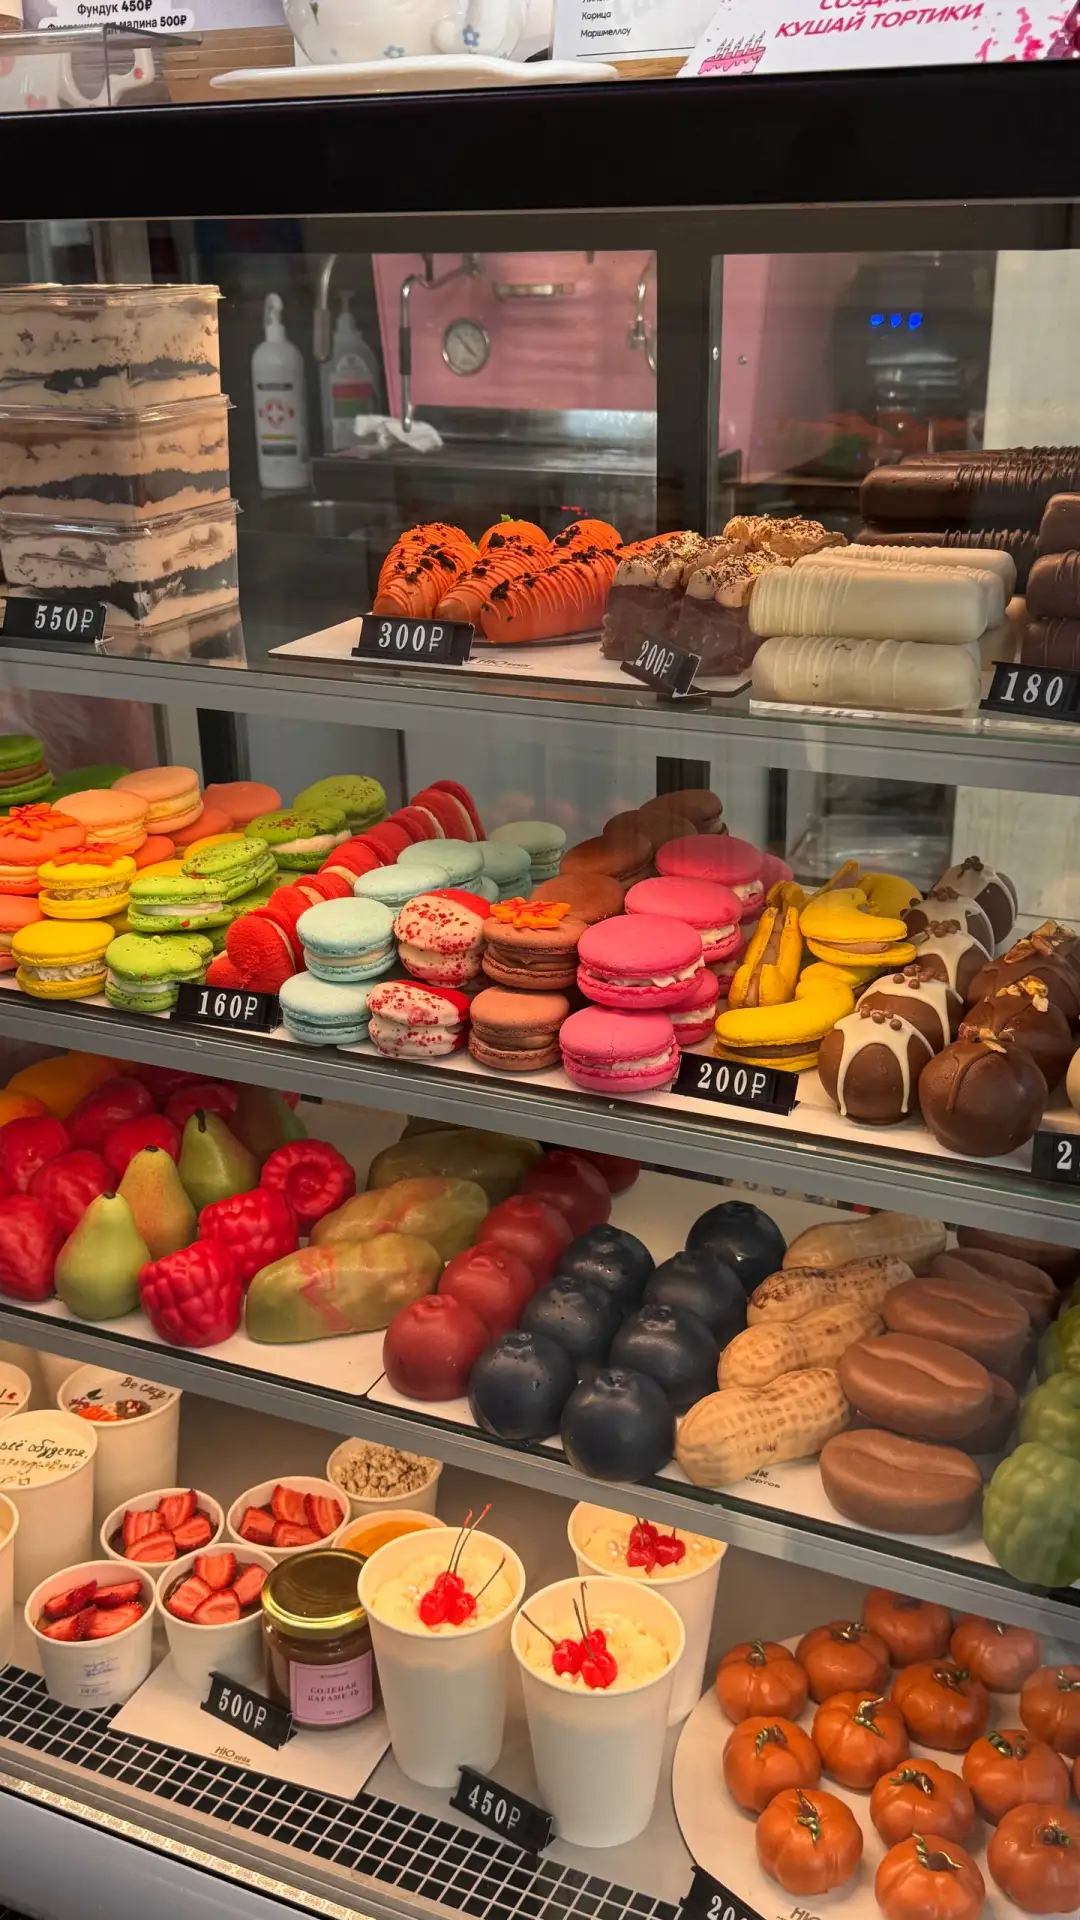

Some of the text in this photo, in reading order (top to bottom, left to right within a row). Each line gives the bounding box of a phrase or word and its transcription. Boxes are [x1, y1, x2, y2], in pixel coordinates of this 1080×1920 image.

[77, 3, 118, 17] Фундук
[582, 11, 612, 21] Корица
[160, 15, 187, 27] 500₽
[775, 3, 985, 39] КУШАЙ ТОРТИКИ
[580, 28, 632, 39] Маршмеллоу
[1000, 671, 1063, 706] 180
[1056, 1140, 1080, 1170] 2
[706, 1895, 748, 1920] 20
